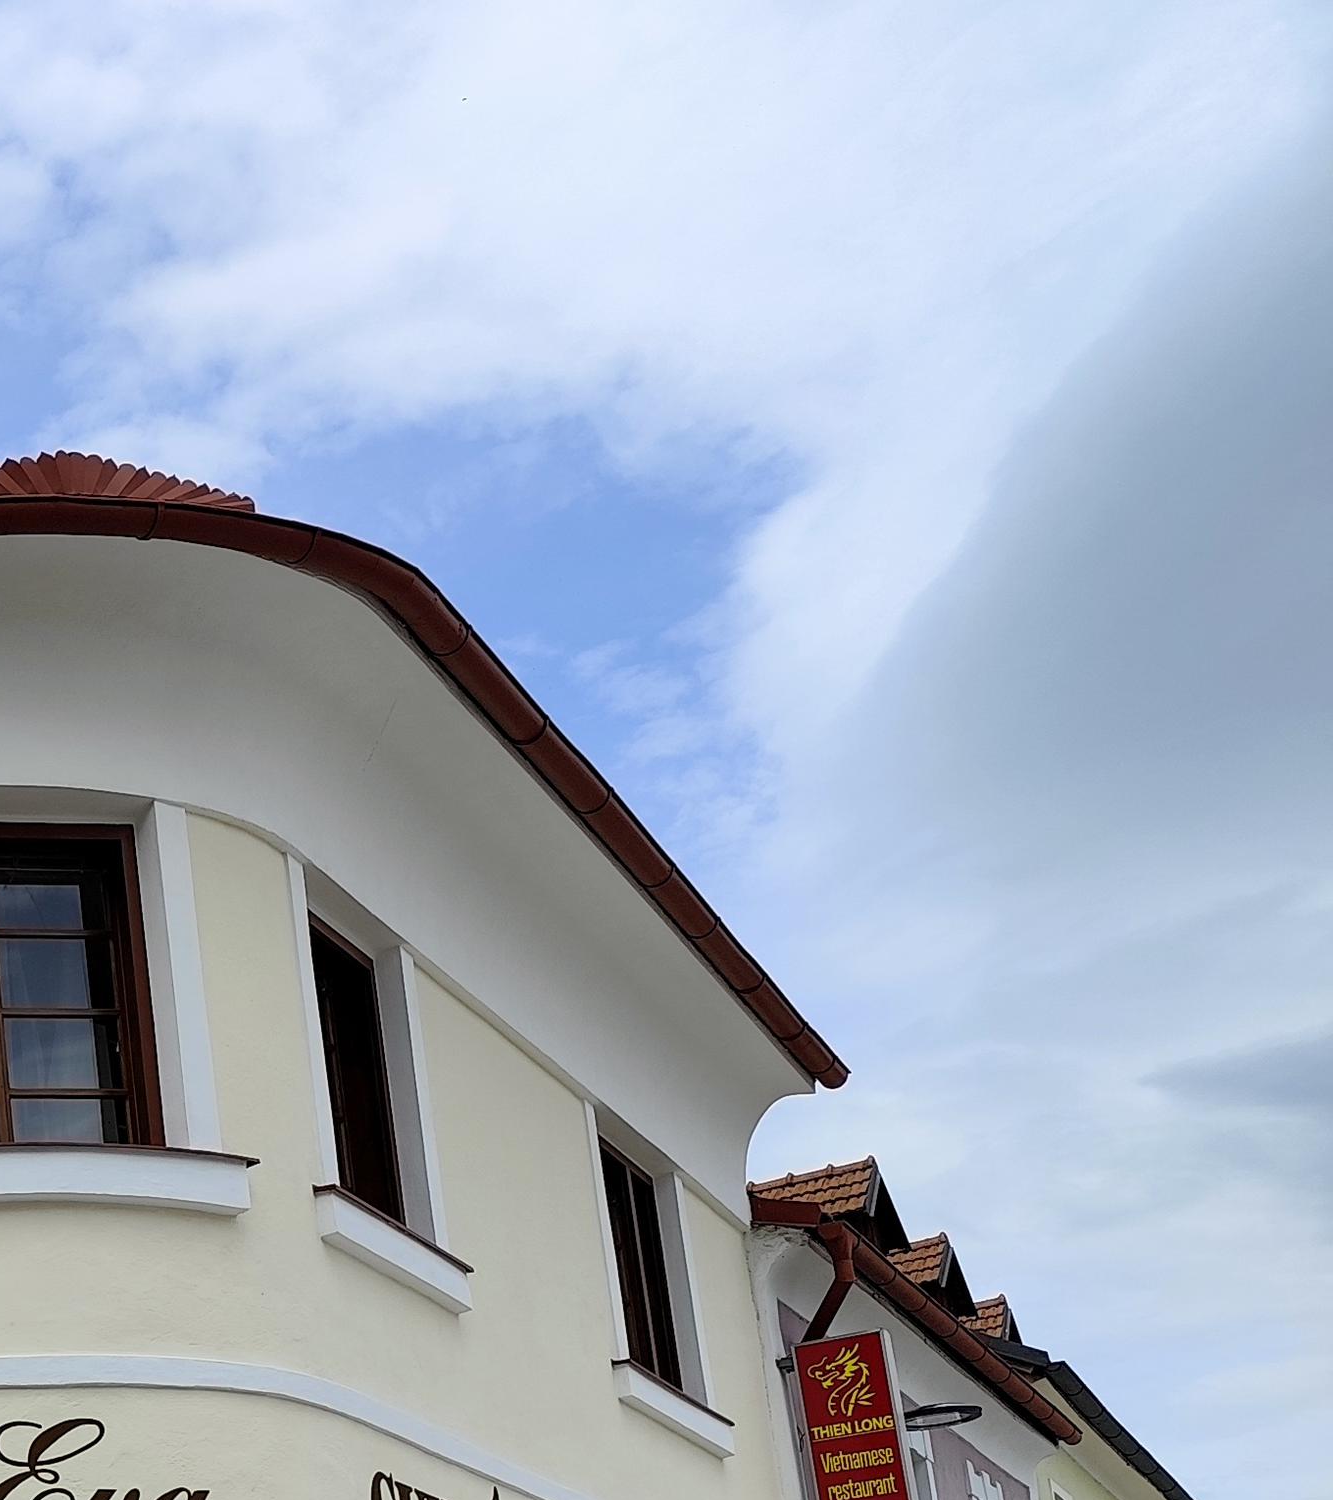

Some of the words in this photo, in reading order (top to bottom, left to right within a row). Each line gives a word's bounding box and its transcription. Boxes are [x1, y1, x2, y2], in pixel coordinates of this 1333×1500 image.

[811, 1421, 852, 1440] THIEN
[855, 1415, 894, 1434] LONG
[820, 1447, 894, 1474] Vietnamese
